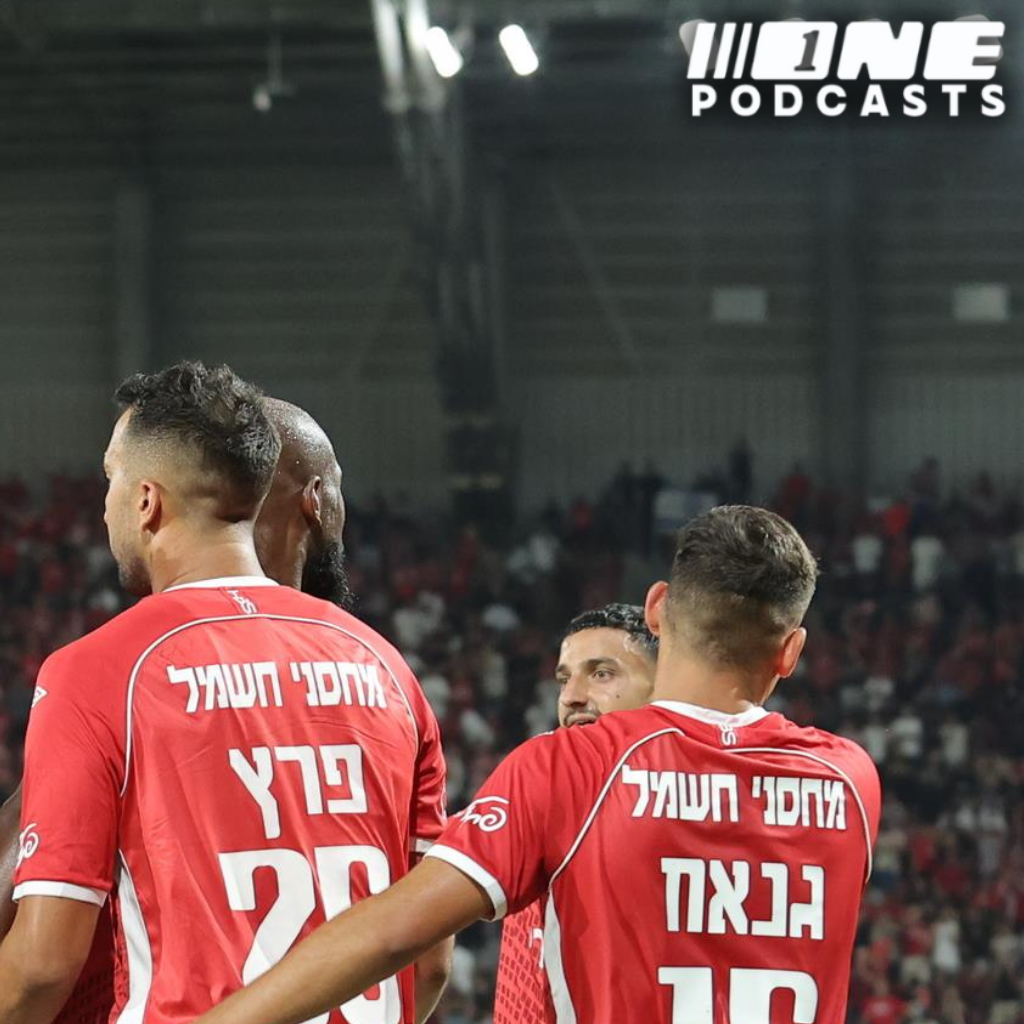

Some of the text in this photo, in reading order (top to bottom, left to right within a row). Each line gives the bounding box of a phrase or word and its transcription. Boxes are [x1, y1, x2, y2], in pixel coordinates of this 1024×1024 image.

[166, 661, 387, 713] מחסני חשמל
[228, 743, 368, 839] פרץ
[622, 764, 846, 830] מחסני חשמל
[660, 857, 825, 941] גנאח
